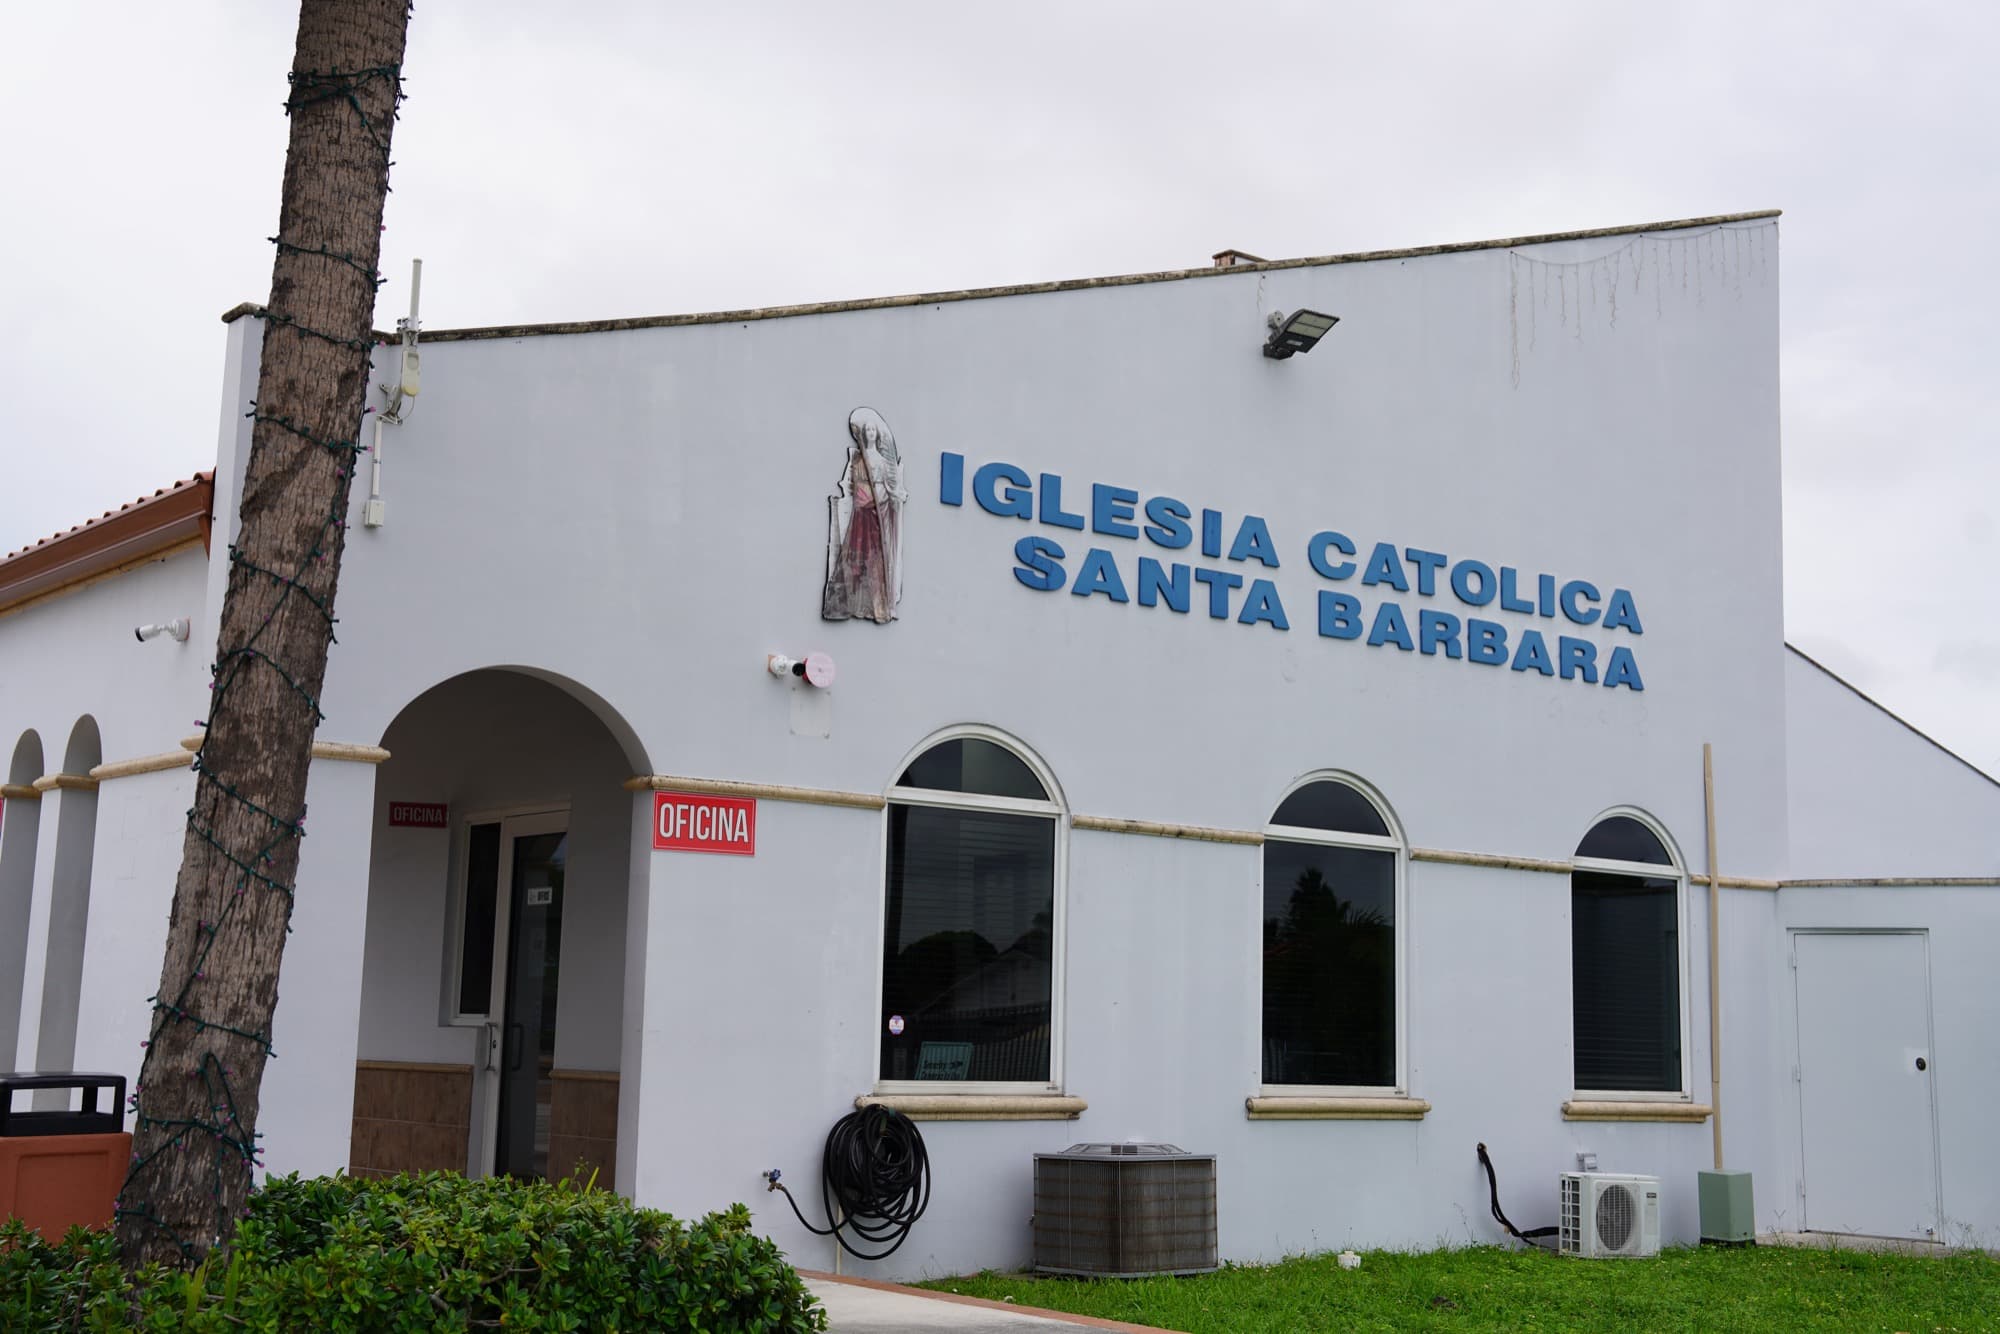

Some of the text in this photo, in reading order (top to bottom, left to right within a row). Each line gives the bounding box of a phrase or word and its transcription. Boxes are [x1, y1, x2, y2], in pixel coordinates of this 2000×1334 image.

[940, 451, 1643, 634] IGLESIA CATOLICA
[1013, 536, 1644, 691] SANTA BARBARA
[393, 806, 443, 824] OFICINA
[659, 802, 749, 843] OFICINA
